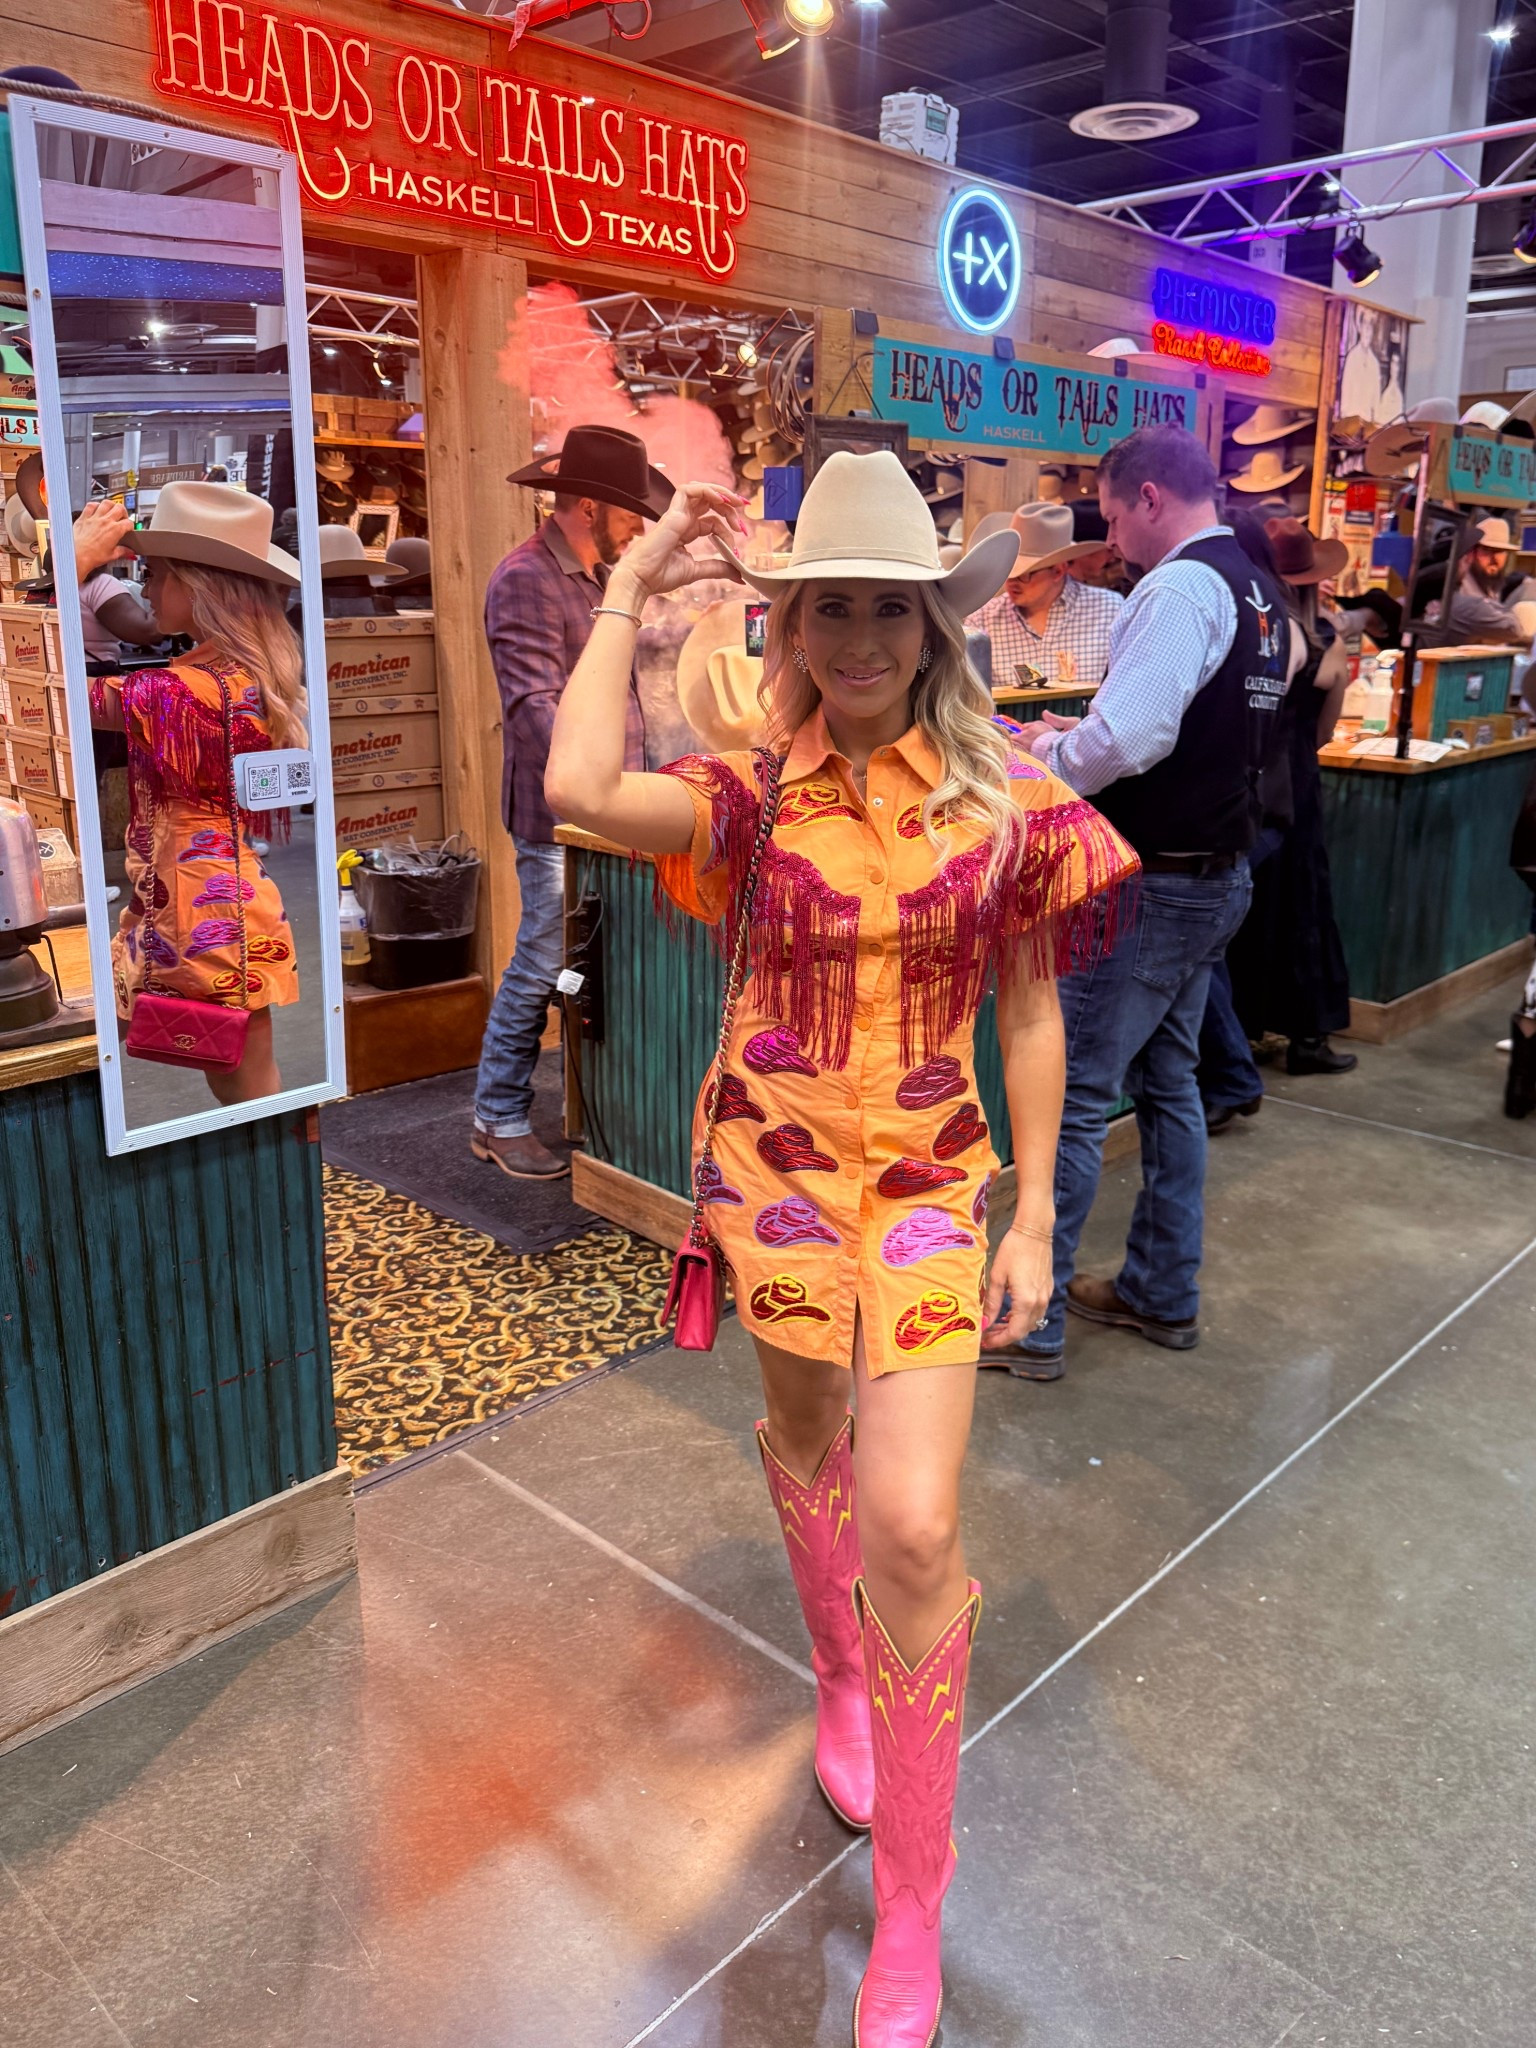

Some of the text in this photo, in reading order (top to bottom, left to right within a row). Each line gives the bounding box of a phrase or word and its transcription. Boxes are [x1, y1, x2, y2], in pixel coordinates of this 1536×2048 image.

[161, 0, 747, 273] HEADS OR TAILS HATS
[369, 162, 692, 254] HASKELL TEXAS
[889, 349, 1187, 447] HEADS OR TAILS HATS
[983, 424, 1047, 444] HASKELL
[327, 655, 411, 682] American
[332, 733, 402, 758] merican
[336, 806, 418, 837] American
